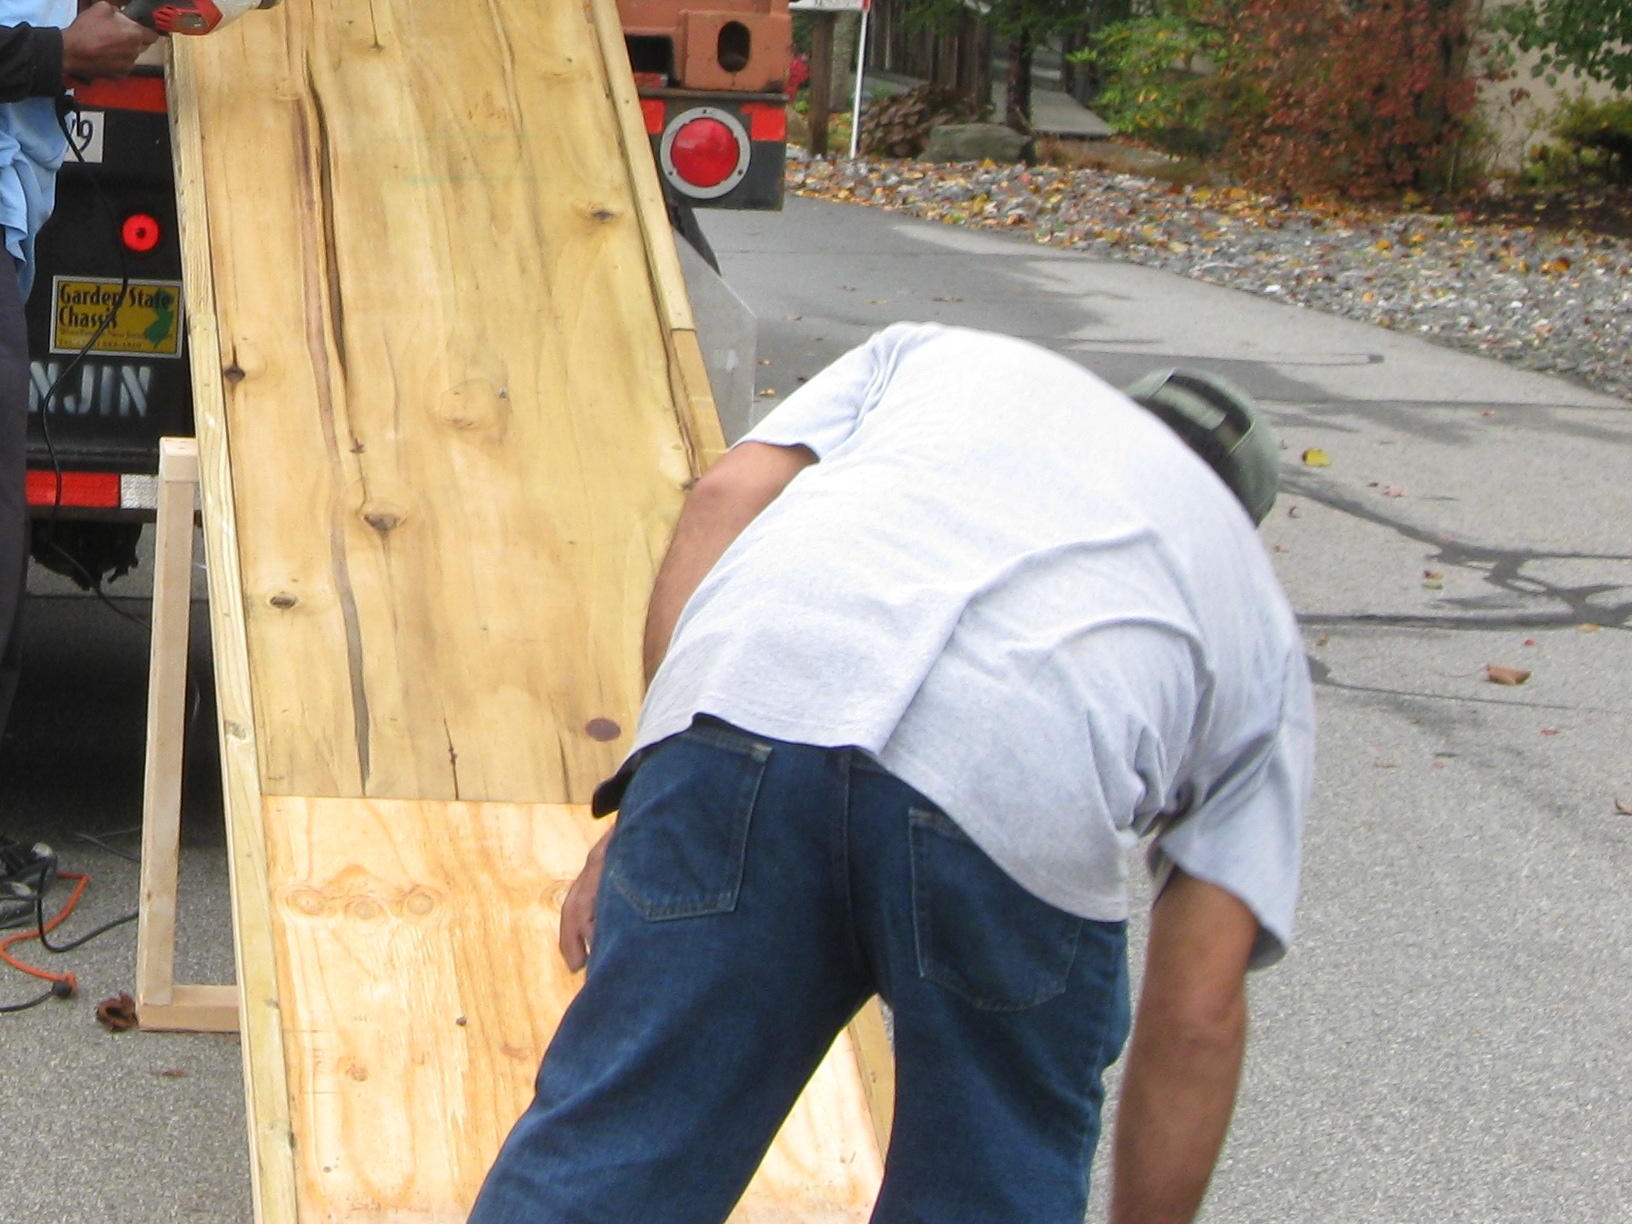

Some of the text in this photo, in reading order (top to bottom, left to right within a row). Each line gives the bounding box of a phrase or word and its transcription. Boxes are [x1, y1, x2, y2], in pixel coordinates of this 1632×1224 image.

[60, 284, 173, 310] Garden State
[58, 306, 117, 329] Chassis
